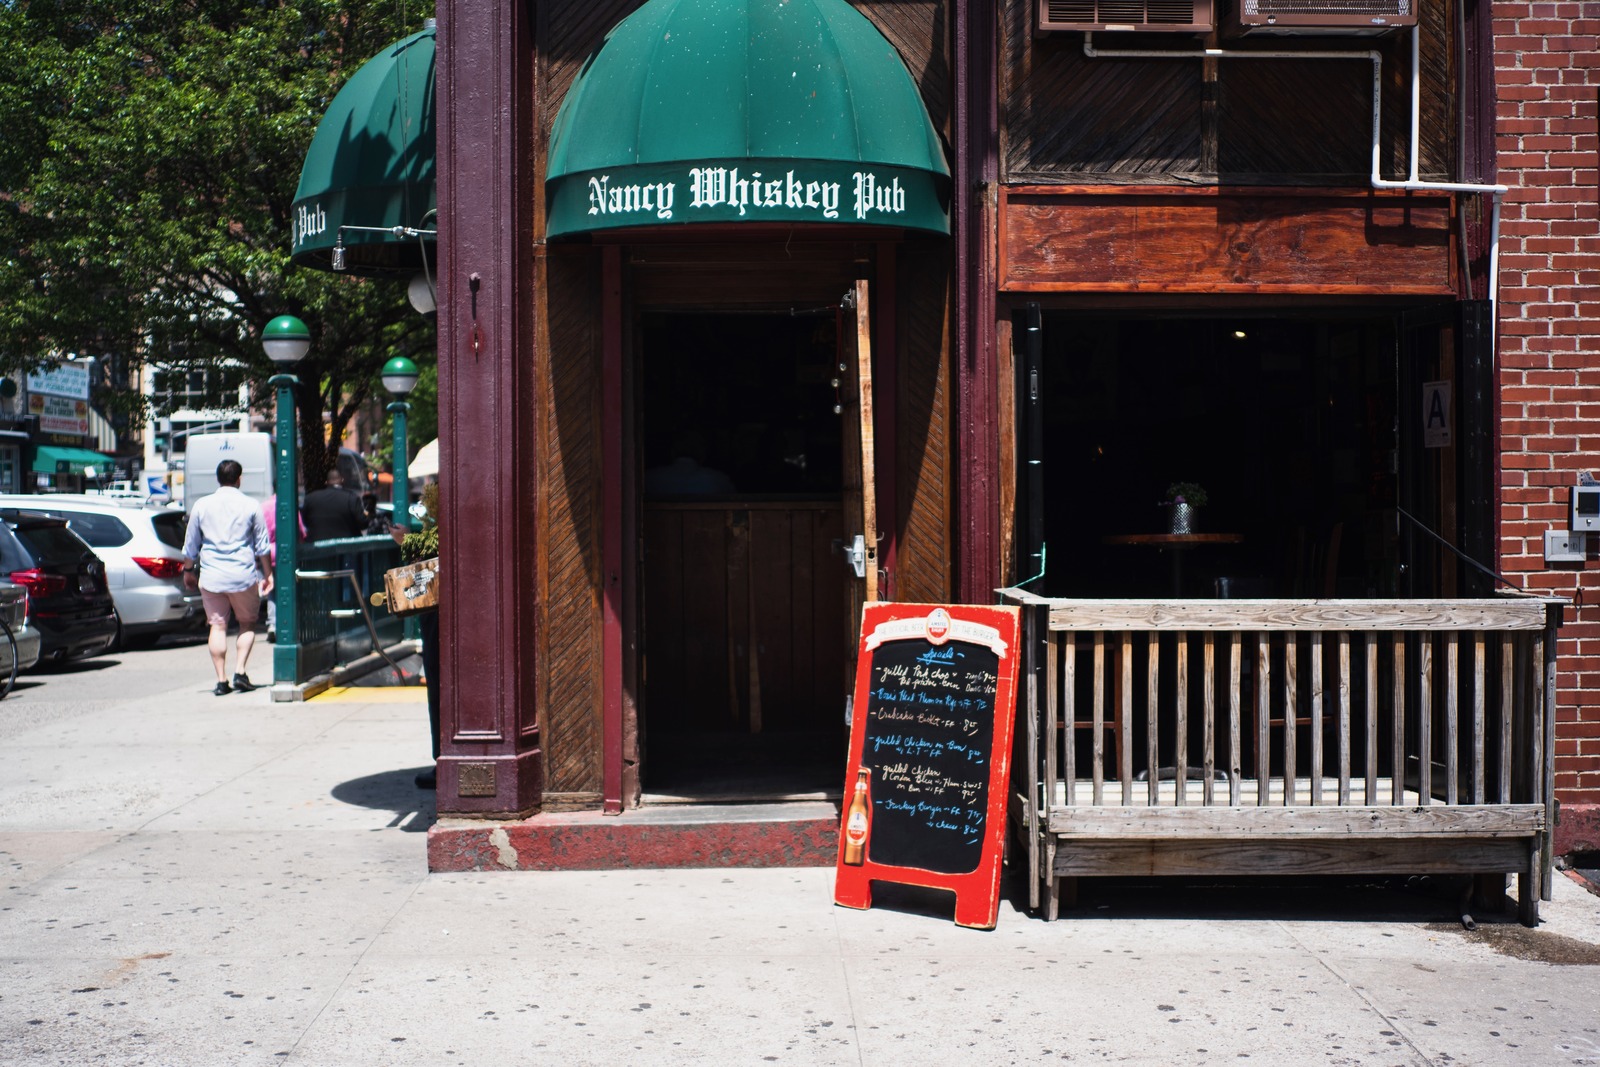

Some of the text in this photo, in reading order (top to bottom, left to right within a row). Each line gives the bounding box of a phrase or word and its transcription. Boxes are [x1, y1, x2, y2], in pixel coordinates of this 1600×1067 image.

[588, 167, 906, 220] Nancy Whiskey Pub
[298, 203, 326, 246] Pub
[1427, 389, 1446, 429] A
